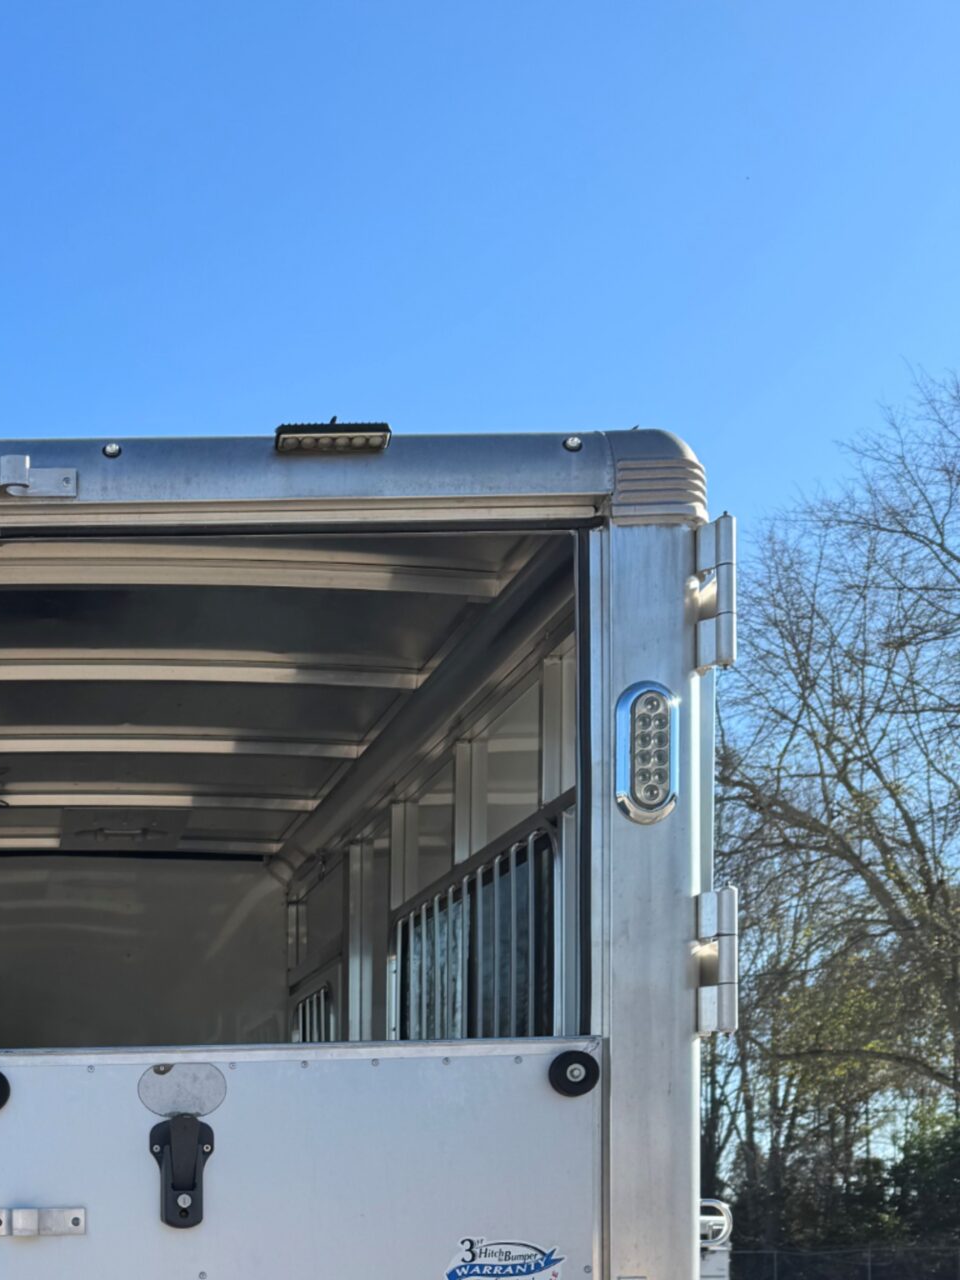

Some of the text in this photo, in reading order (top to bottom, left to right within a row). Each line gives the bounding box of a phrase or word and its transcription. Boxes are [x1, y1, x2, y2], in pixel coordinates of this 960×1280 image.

[460, 1238, 476, 1264] 3
[504, 1251, 538, 1264] Bumper
[455, 1258, 546, 1276] WARRANTY
